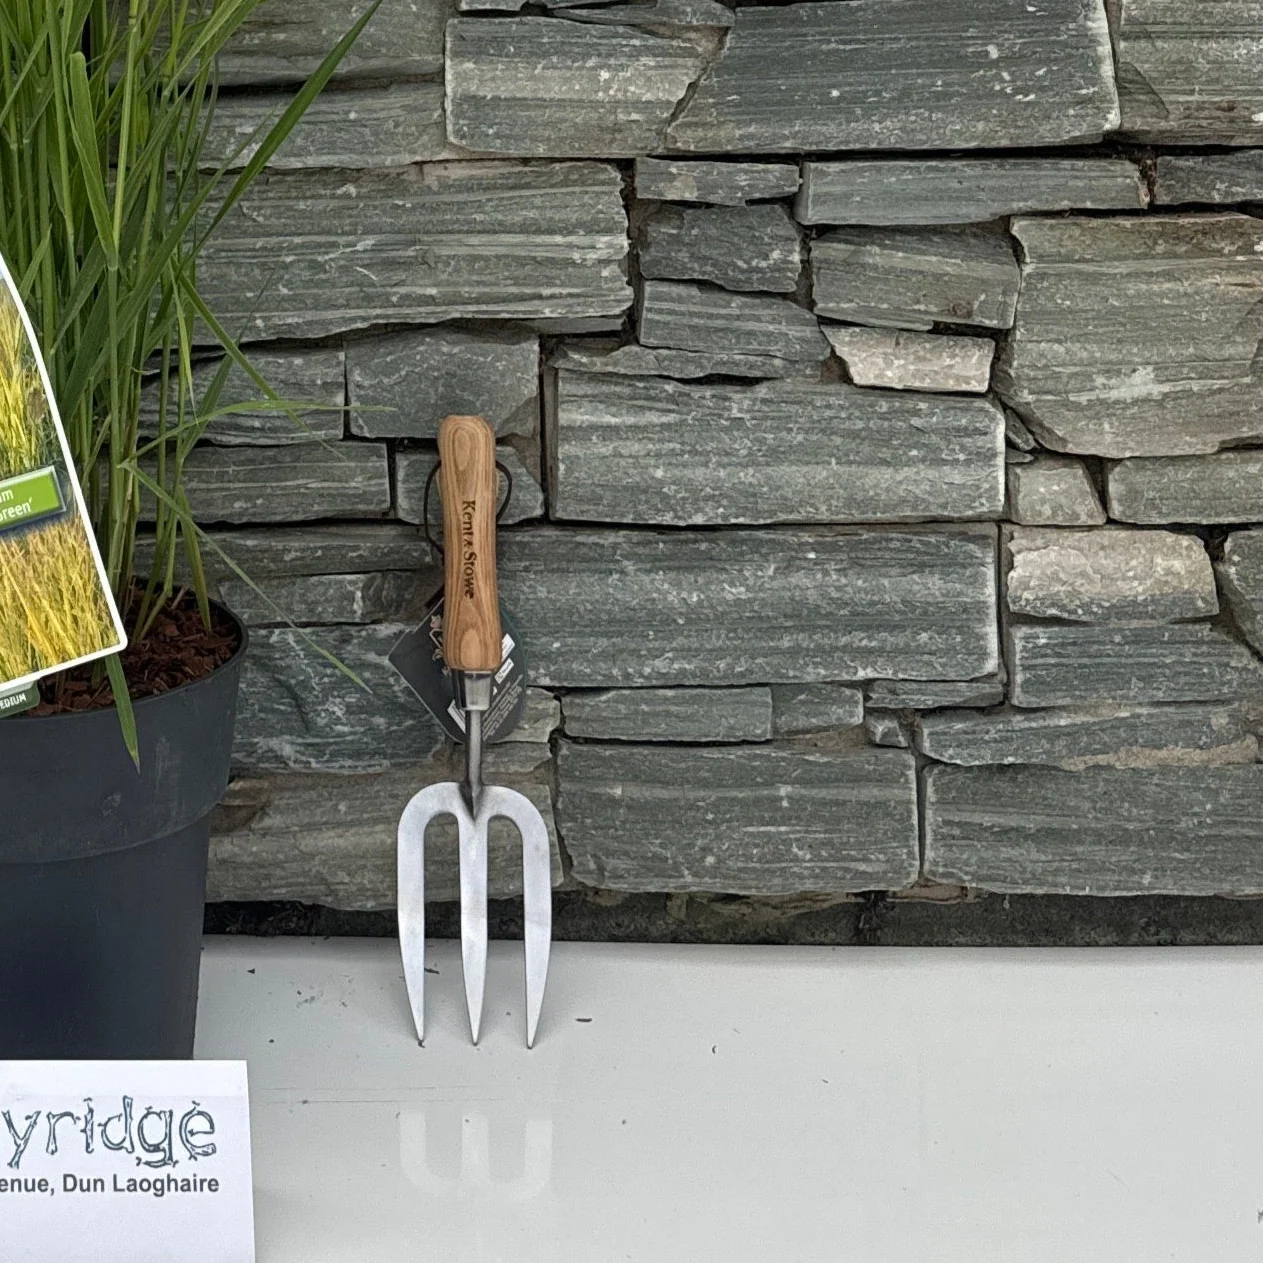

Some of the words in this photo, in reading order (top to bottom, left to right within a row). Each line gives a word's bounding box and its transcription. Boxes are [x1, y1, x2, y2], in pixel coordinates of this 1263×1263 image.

[462, 500, 476, 535] Kent
[463, 551, 477, 599] Stowe
[63, 1175, 105, 1193] Dun
[113, 1174, 220, 1197] Laoghaire
